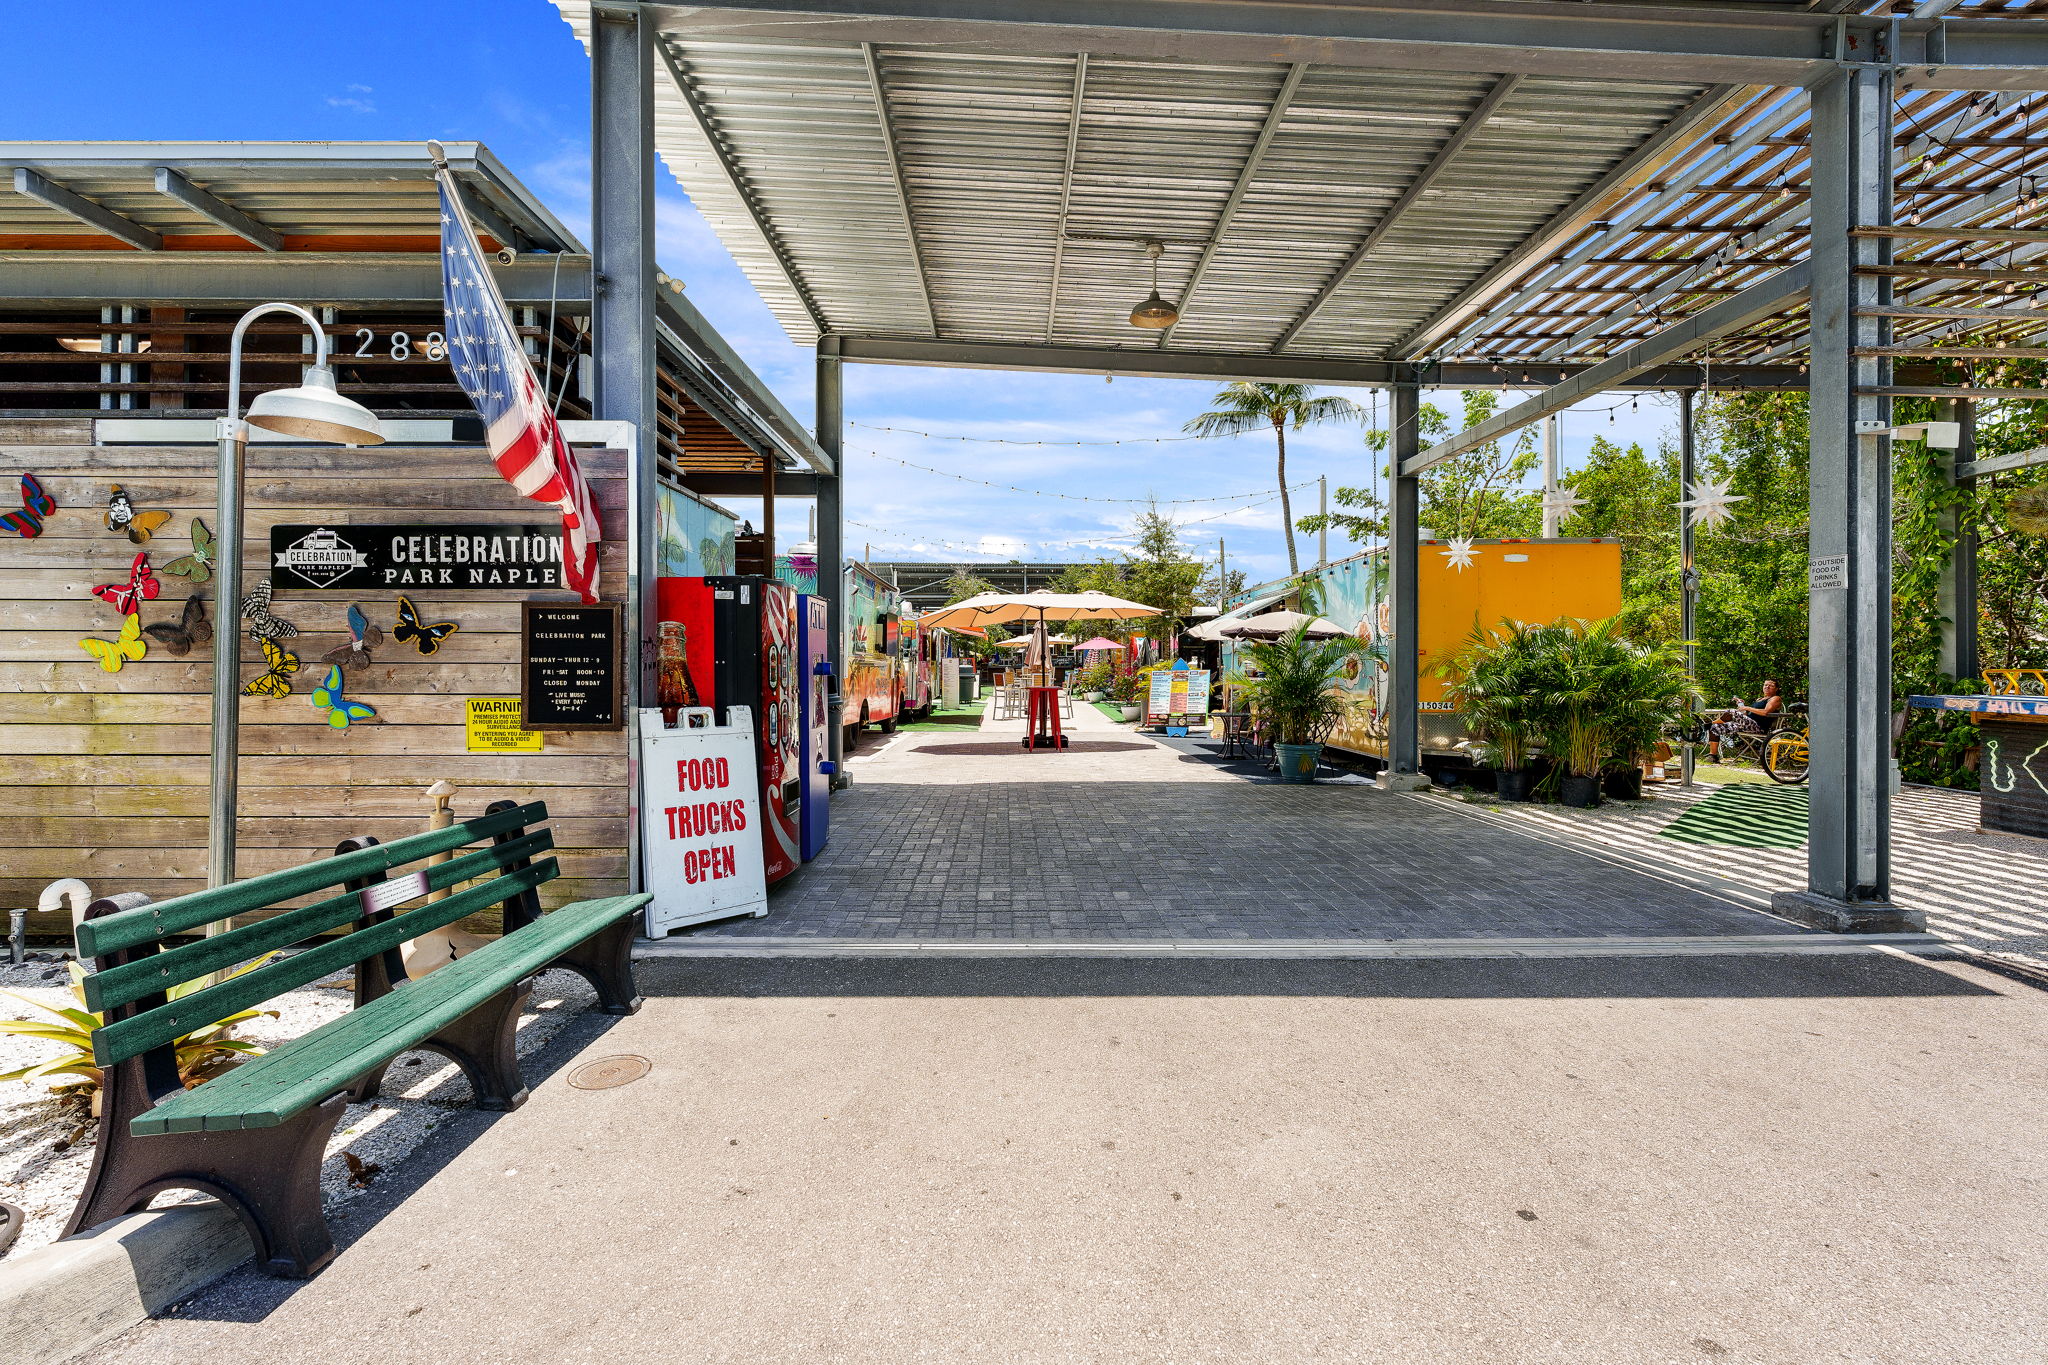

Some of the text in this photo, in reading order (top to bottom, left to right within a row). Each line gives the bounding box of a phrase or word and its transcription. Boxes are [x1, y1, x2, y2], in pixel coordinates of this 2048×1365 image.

[290, 551, 353, 562] CELEBRATION
[391, 536, 563, 563] CELEBRATION
[1818, 558, 1845, 566] OUTSIDE
[384, 569, 453, 584] PARK
[1811, 581, 1842, 589] ALLOWED
[677, 757, 729, 792] FOOD
[664, 799, 746, 840] TRUCKS
[684, 845, 736, 884] OPEN
